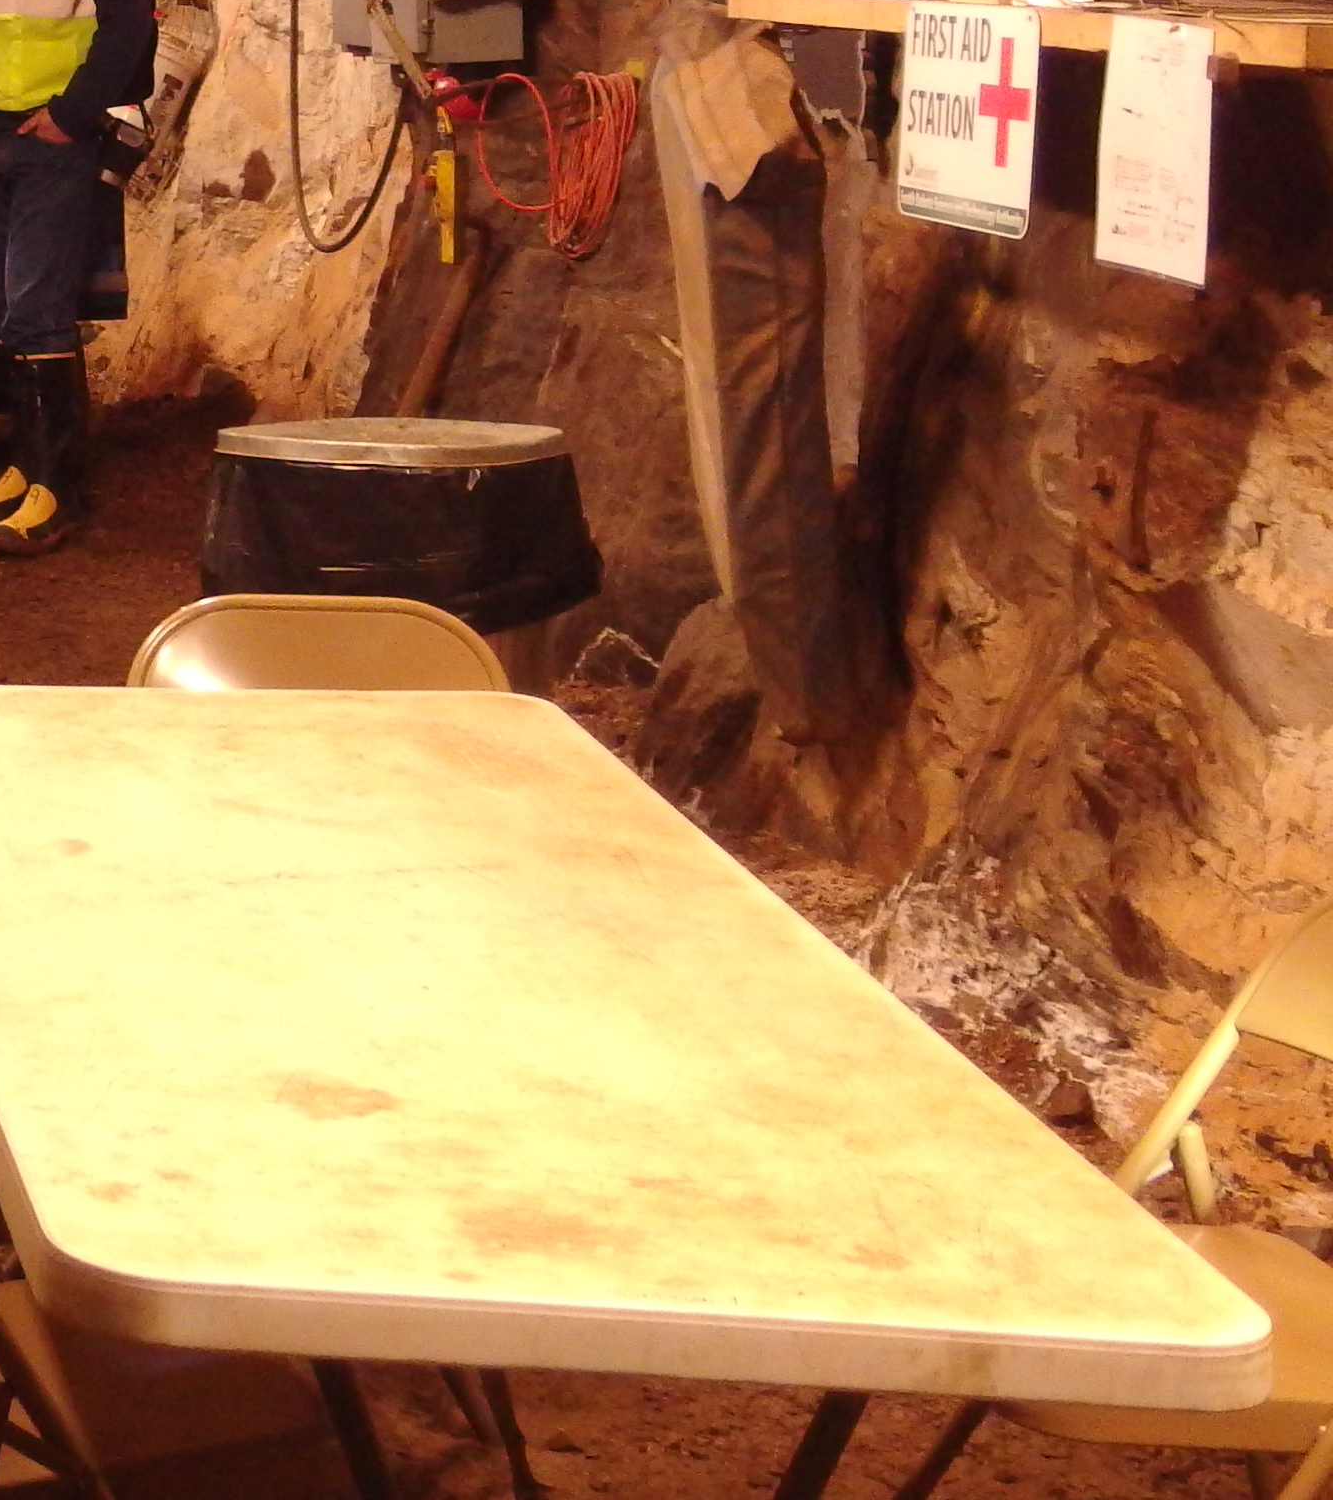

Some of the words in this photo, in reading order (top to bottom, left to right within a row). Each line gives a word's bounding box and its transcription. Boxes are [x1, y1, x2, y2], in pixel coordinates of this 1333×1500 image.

[912, 13, 958, 59] FIRST
[960, 16, 992, 63] AID
[907, 88, 975, 141] STATION
